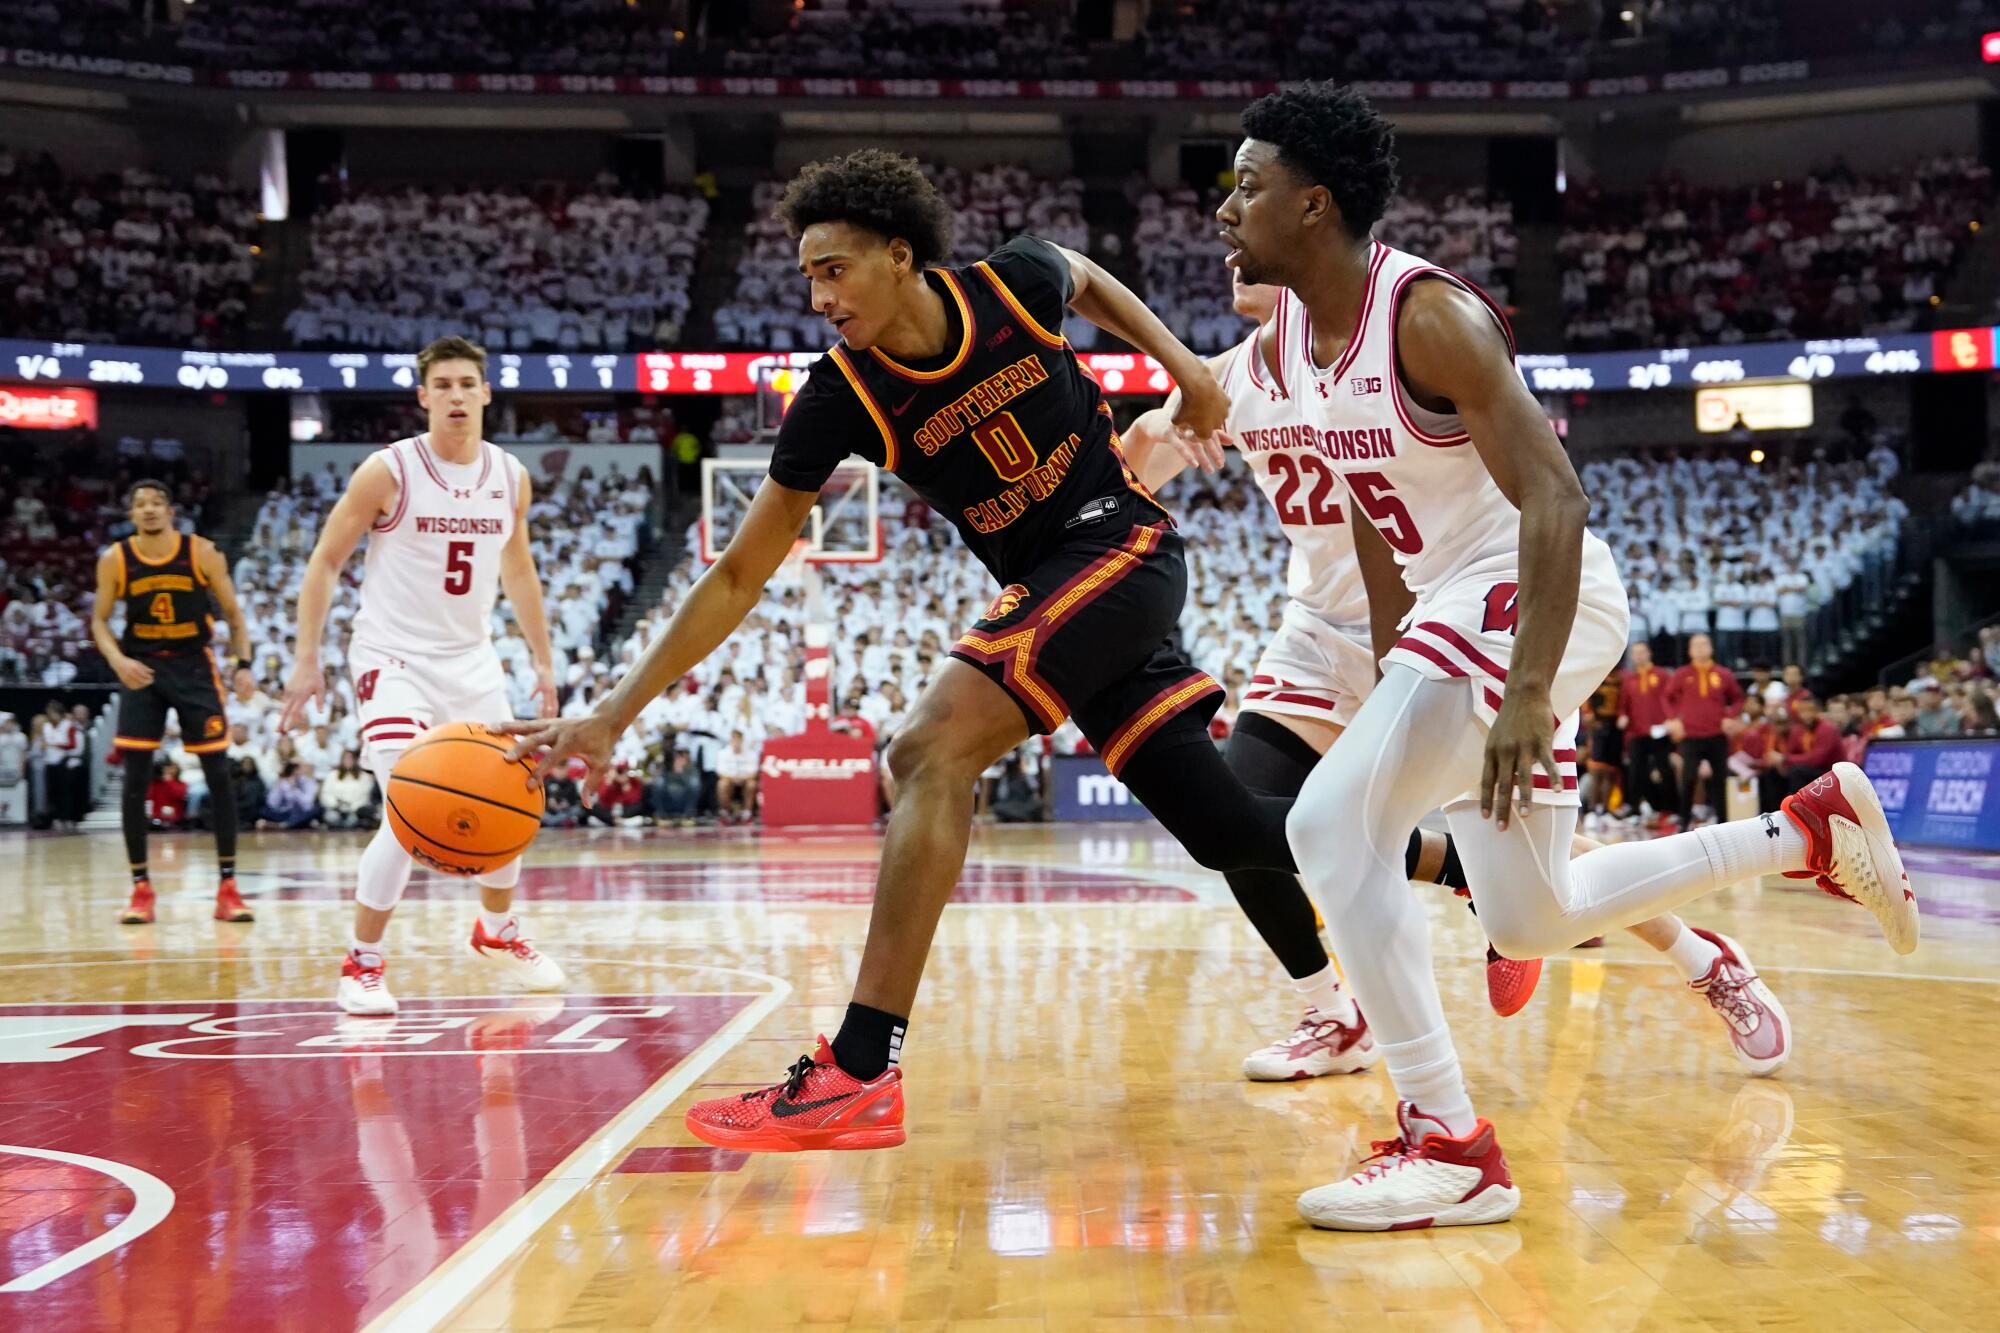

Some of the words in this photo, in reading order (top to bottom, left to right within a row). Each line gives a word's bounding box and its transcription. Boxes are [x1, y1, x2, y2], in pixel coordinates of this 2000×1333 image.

[15, 49, 194, 83] CHAMPIONS
[229, 70, 289, 87] 1907
[178, 365, 228, 389] 0/0
[263, 367, 303, 388] 0%
[342, 367, 356, 388] 1
[393, 367, 414, 387] 4
[553, 367, 567, 388] 1
[598, 367, 612, 388] 1
[1148, 370, 1169, 390] 4
[1351, 377, 1382, 396] BIG
[914, 354, 1049, 456] SOUTHERN
[971, 411, 1038, 483] 0
[1241, 425, 1314, 452] WISCONS
[1312, 428, 1397, 461] CONSIN
[963, 433, 1082, 534] CALIFORNIA
[1268, 452, 1345, 527] 22
[1105, 501, 1116, 510] 46
[1344, 471, 1424, 556] 5
[416, 516, 504, 535] WISCONSIN
[445, 541, 476, 596] 5
[150, 592, 176, 624] 4
[775, 757, 873, 775] MUELLER
[1926, 778, 1987, 814] FLESCH
